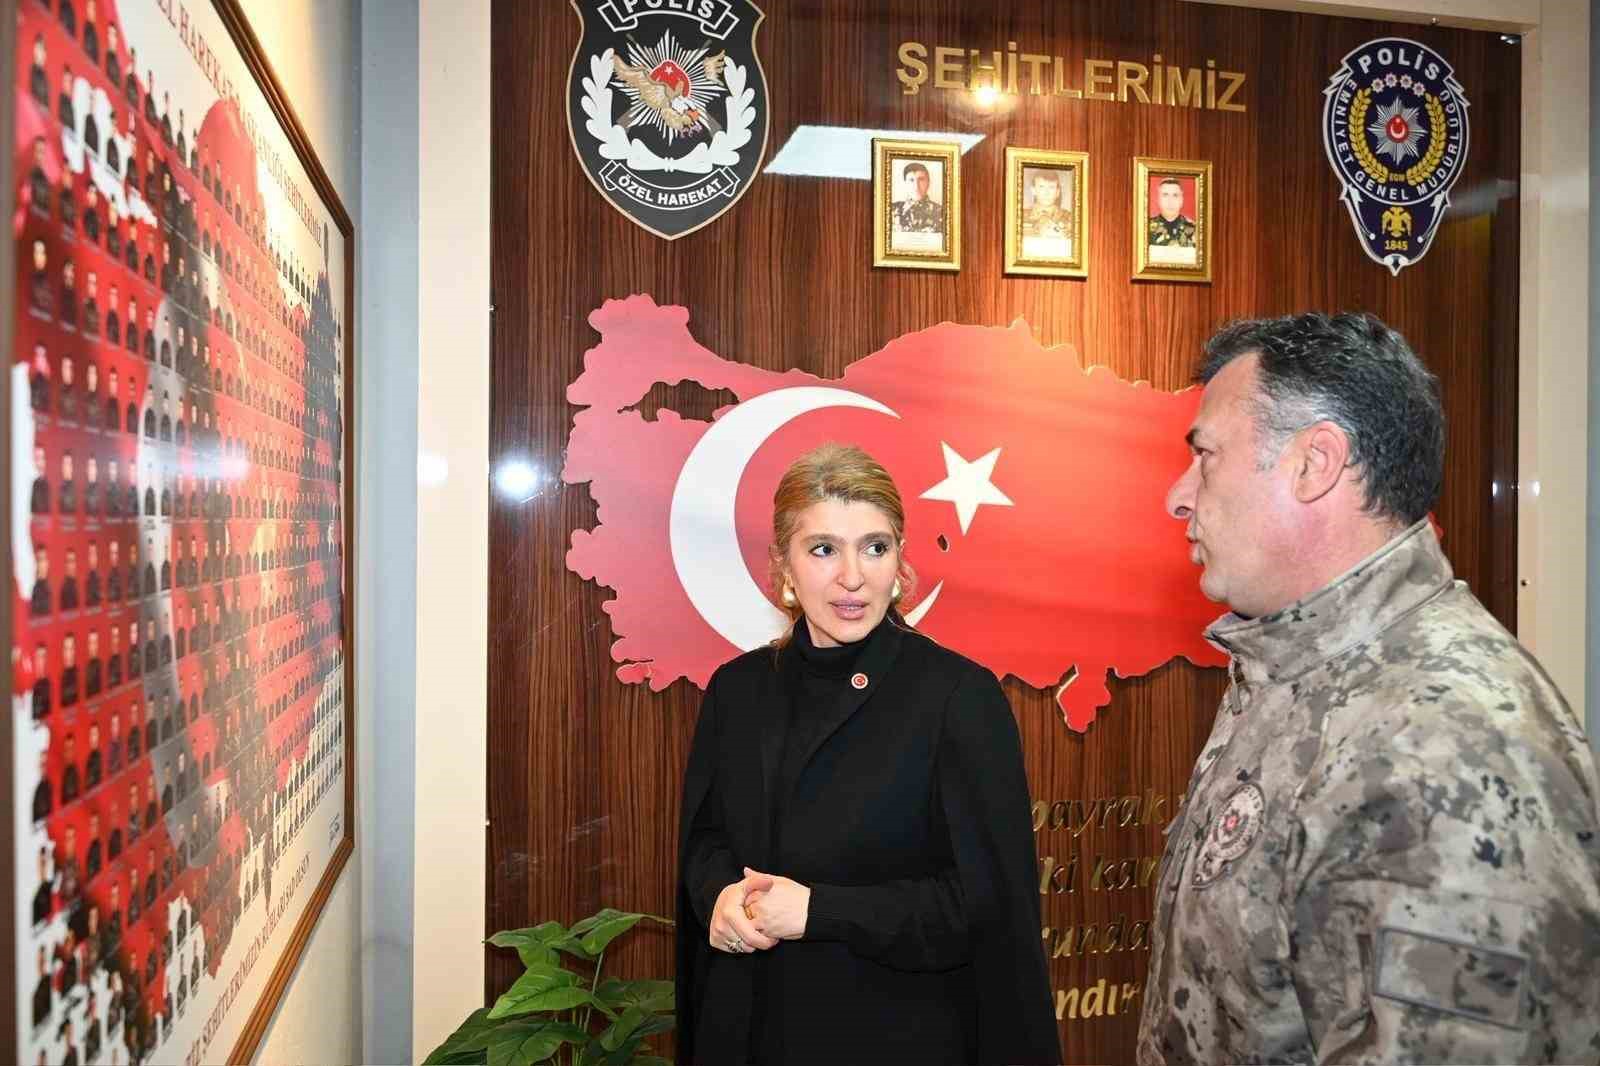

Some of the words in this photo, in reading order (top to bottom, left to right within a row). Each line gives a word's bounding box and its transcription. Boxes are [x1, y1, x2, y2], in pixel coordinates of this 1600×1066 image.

[896, 41, 1246, 112] ŞEHİTLERİMİZ
[1357, 48, 1440, 80] POLİS
[618, 175, 653, 202] ÖZEL
[657, 178, 722, 205] HAREKAT
[1355, 170, 1409, 200] GENEL
